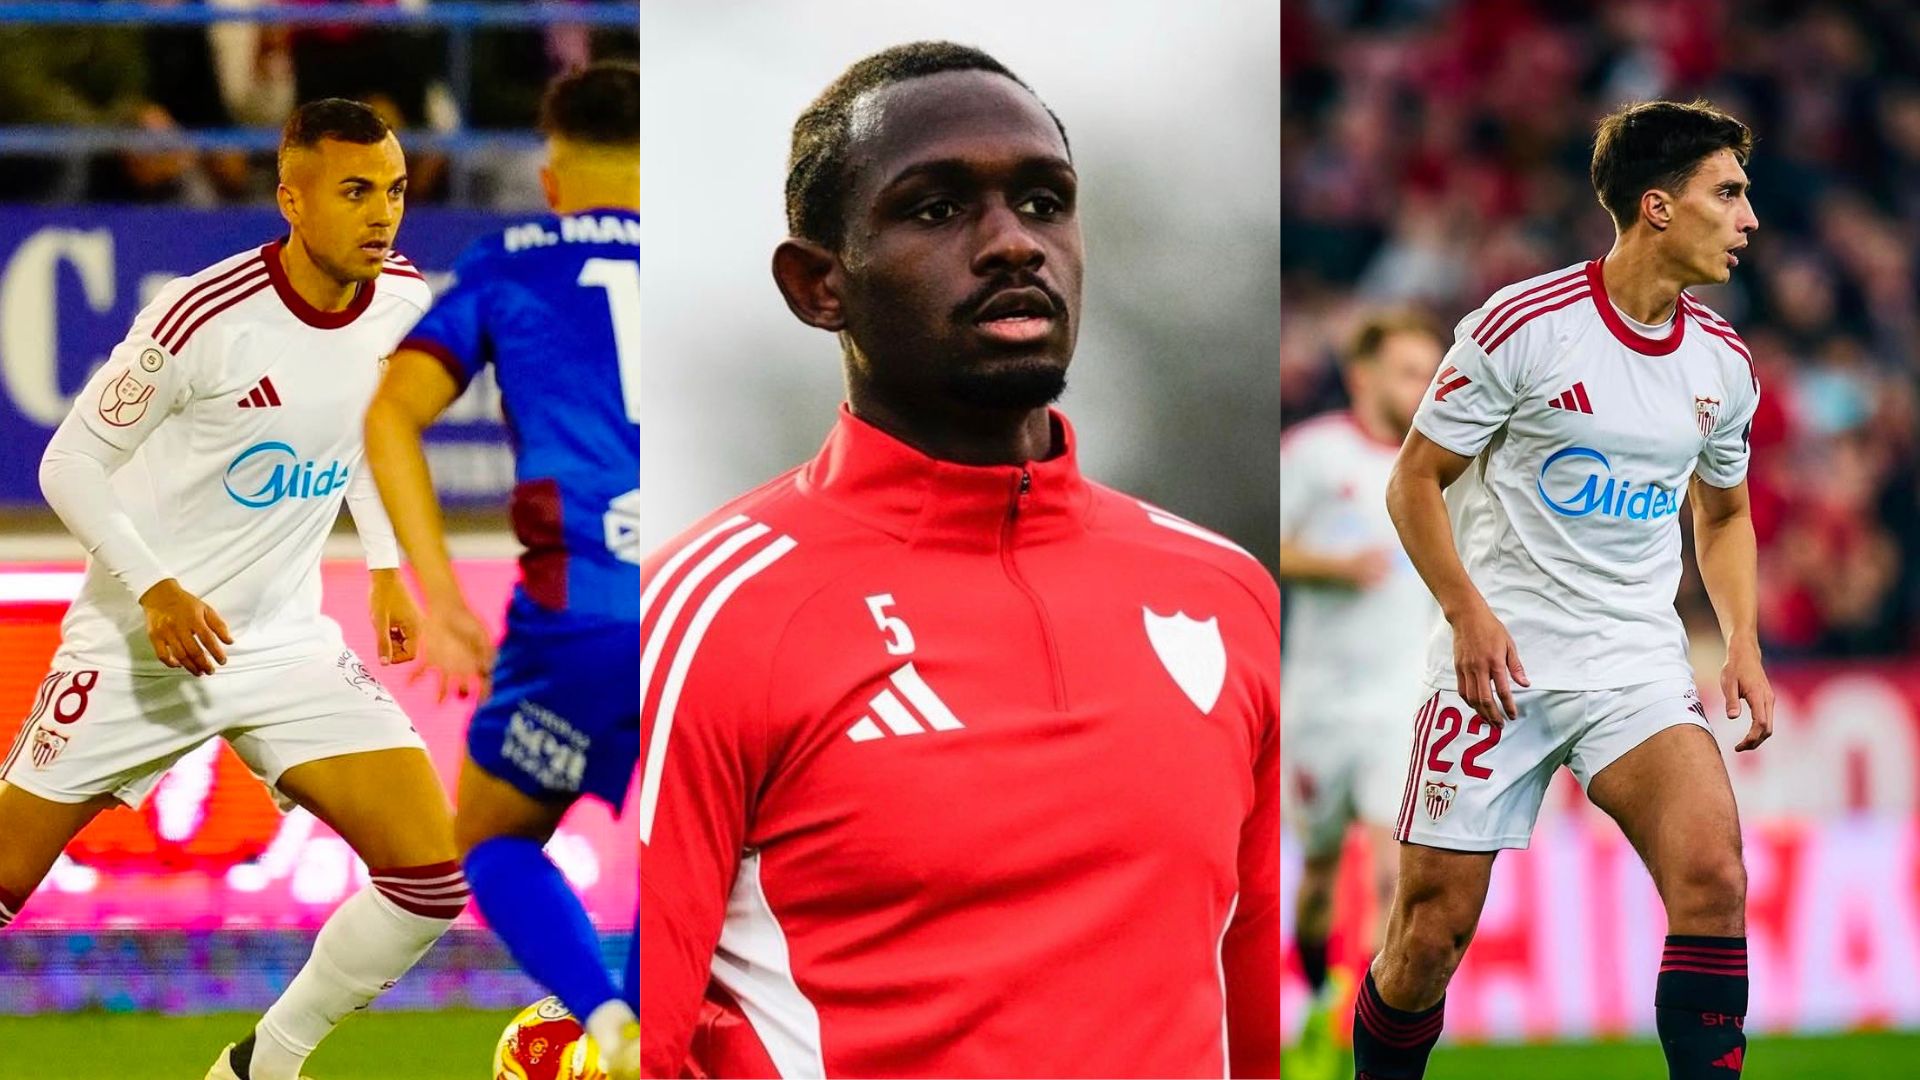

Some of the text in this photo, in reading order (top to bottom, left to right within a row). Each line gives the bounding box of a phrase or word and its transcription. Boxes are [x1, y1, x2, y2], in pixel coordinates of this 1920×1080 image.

[864, 593, 916, 656] 5
[54, 670, 99, 724] 8
[1427, 706, 1502, 780] 22
